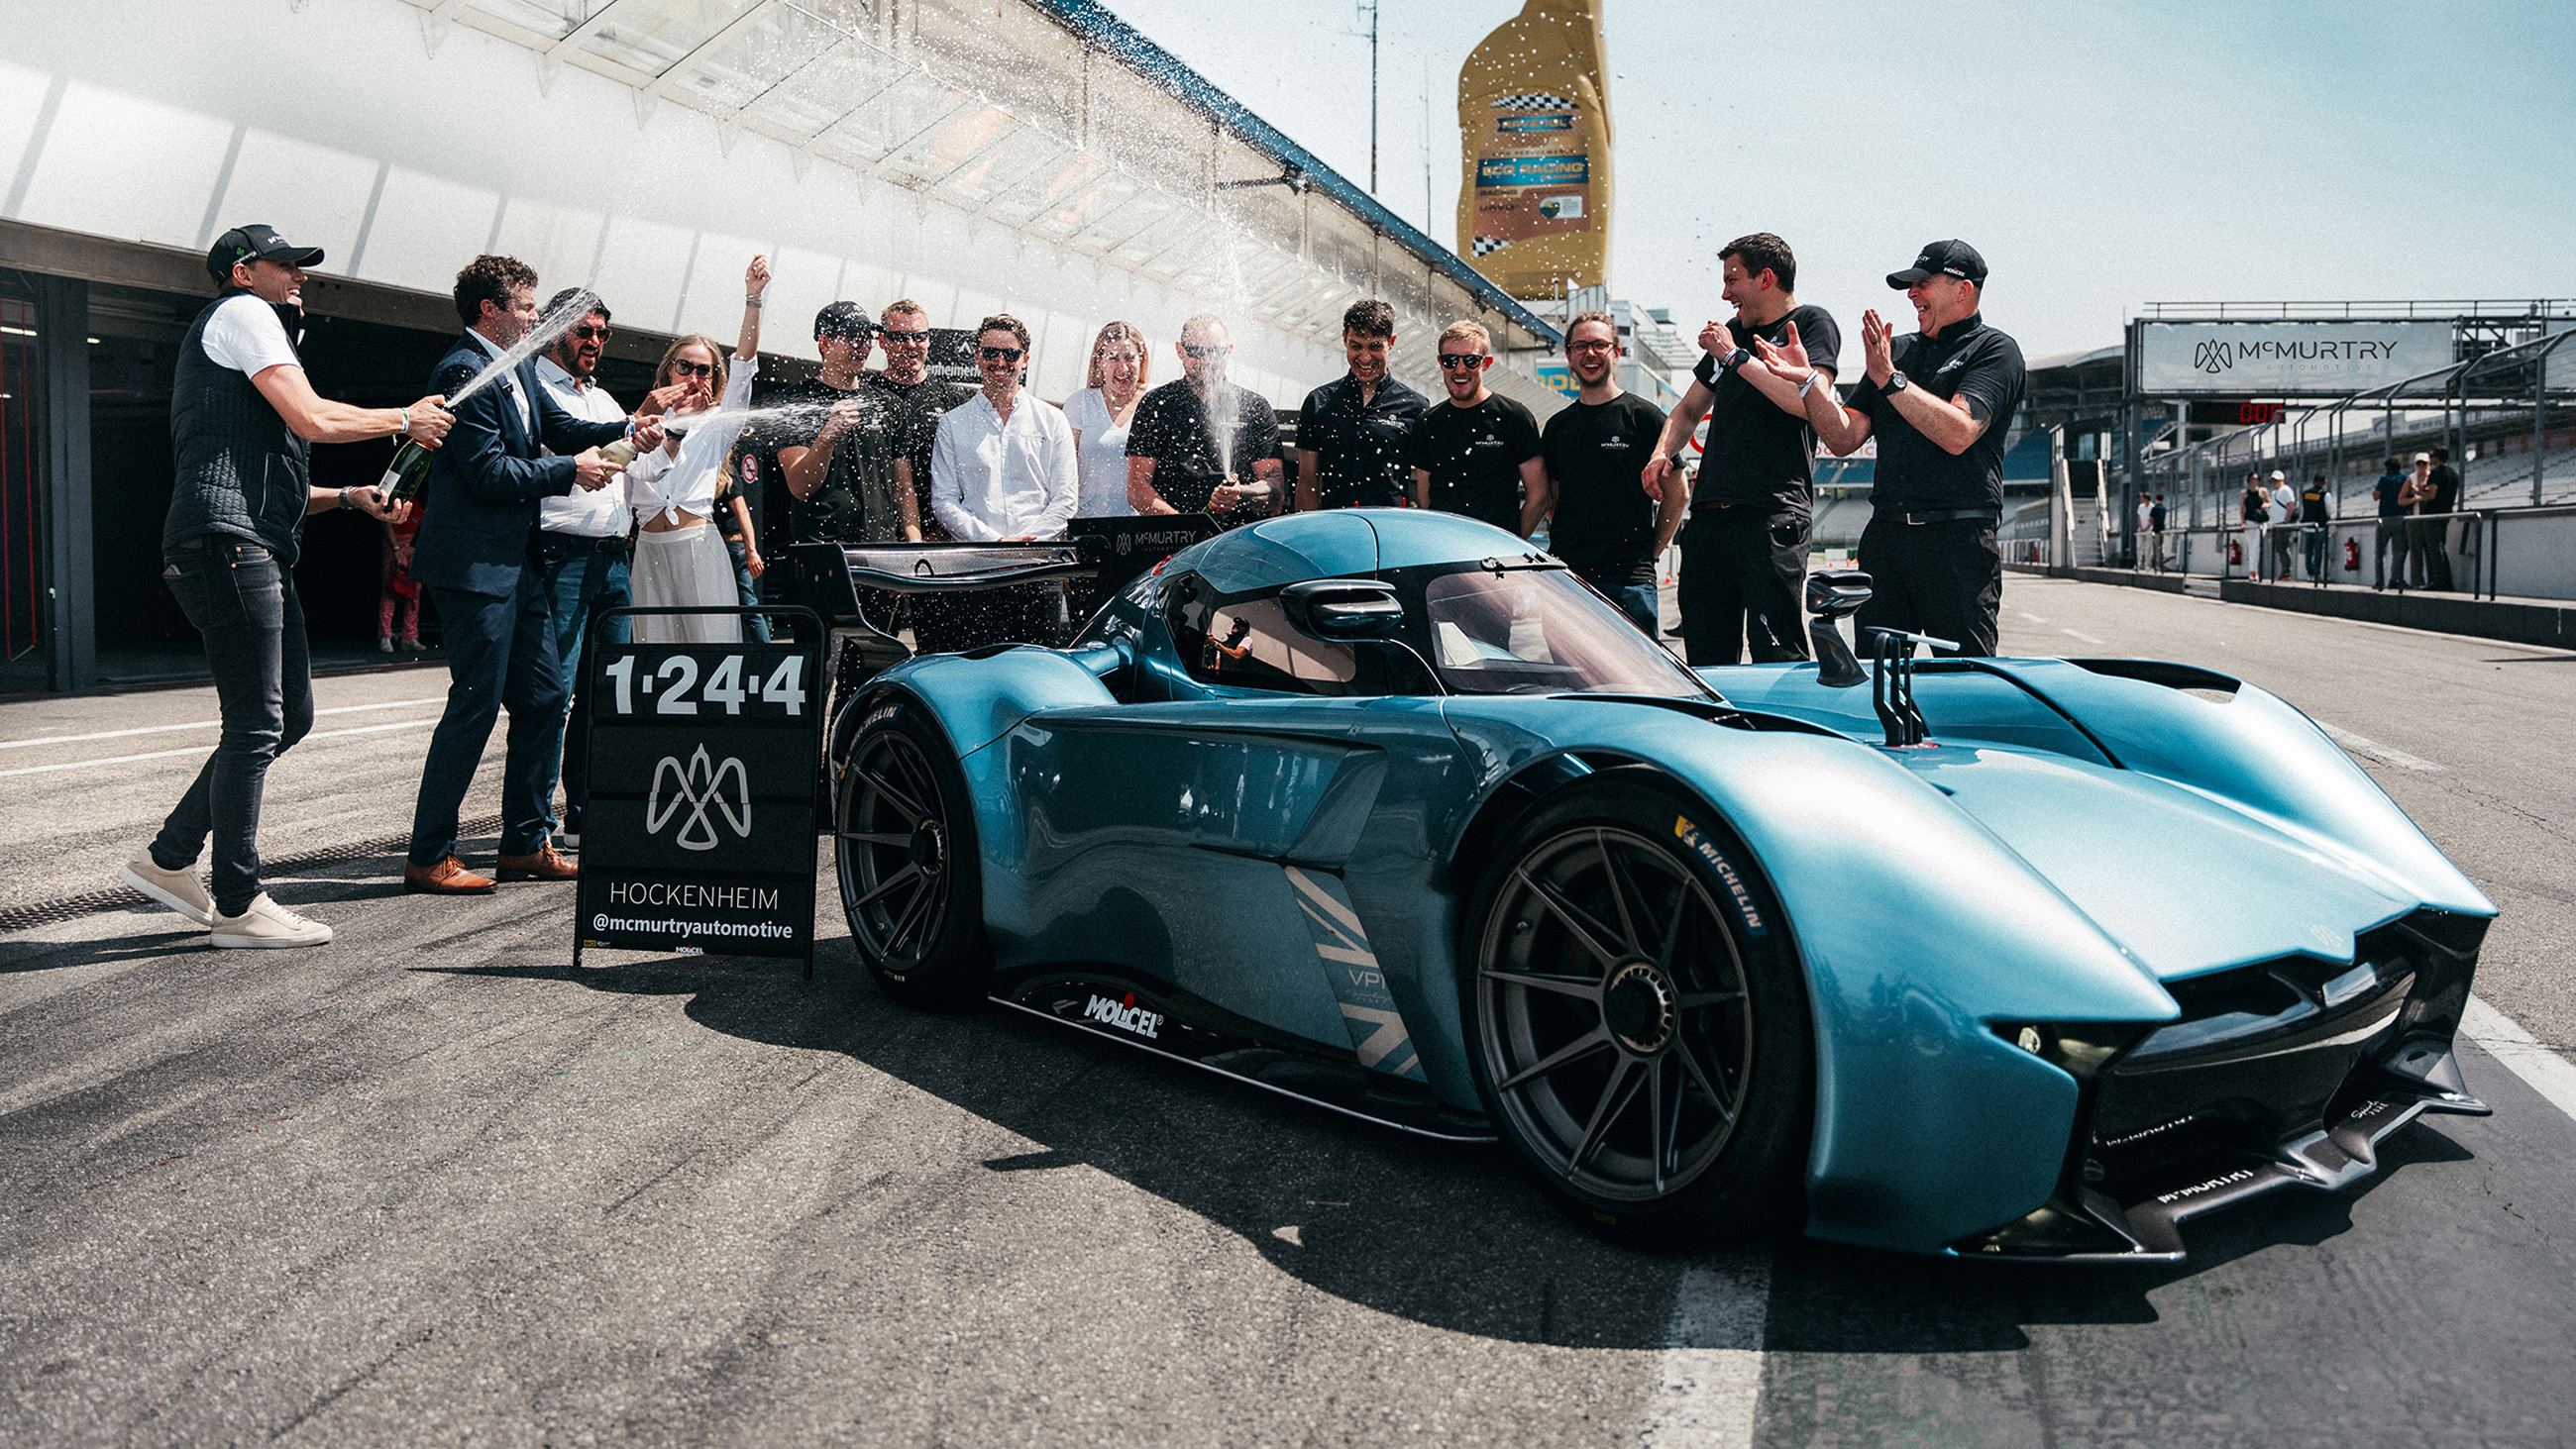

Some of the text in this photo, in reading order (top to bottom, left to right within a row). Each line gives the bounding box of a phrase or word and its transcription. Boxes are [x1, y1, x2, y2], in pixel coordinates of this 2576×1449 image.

[1482, 162, 1583, 176] ECO RACING
[2239, 341, 2398, 360] McMURTRY
[1134, 530, 1197, 546] McMURTRY
[609, 881, 779, 910] HOCKENHEIM
[1697, 841, 1763, 928] MICHELIN
[592, 913, 794, 939] @mcmurtryautomotive
